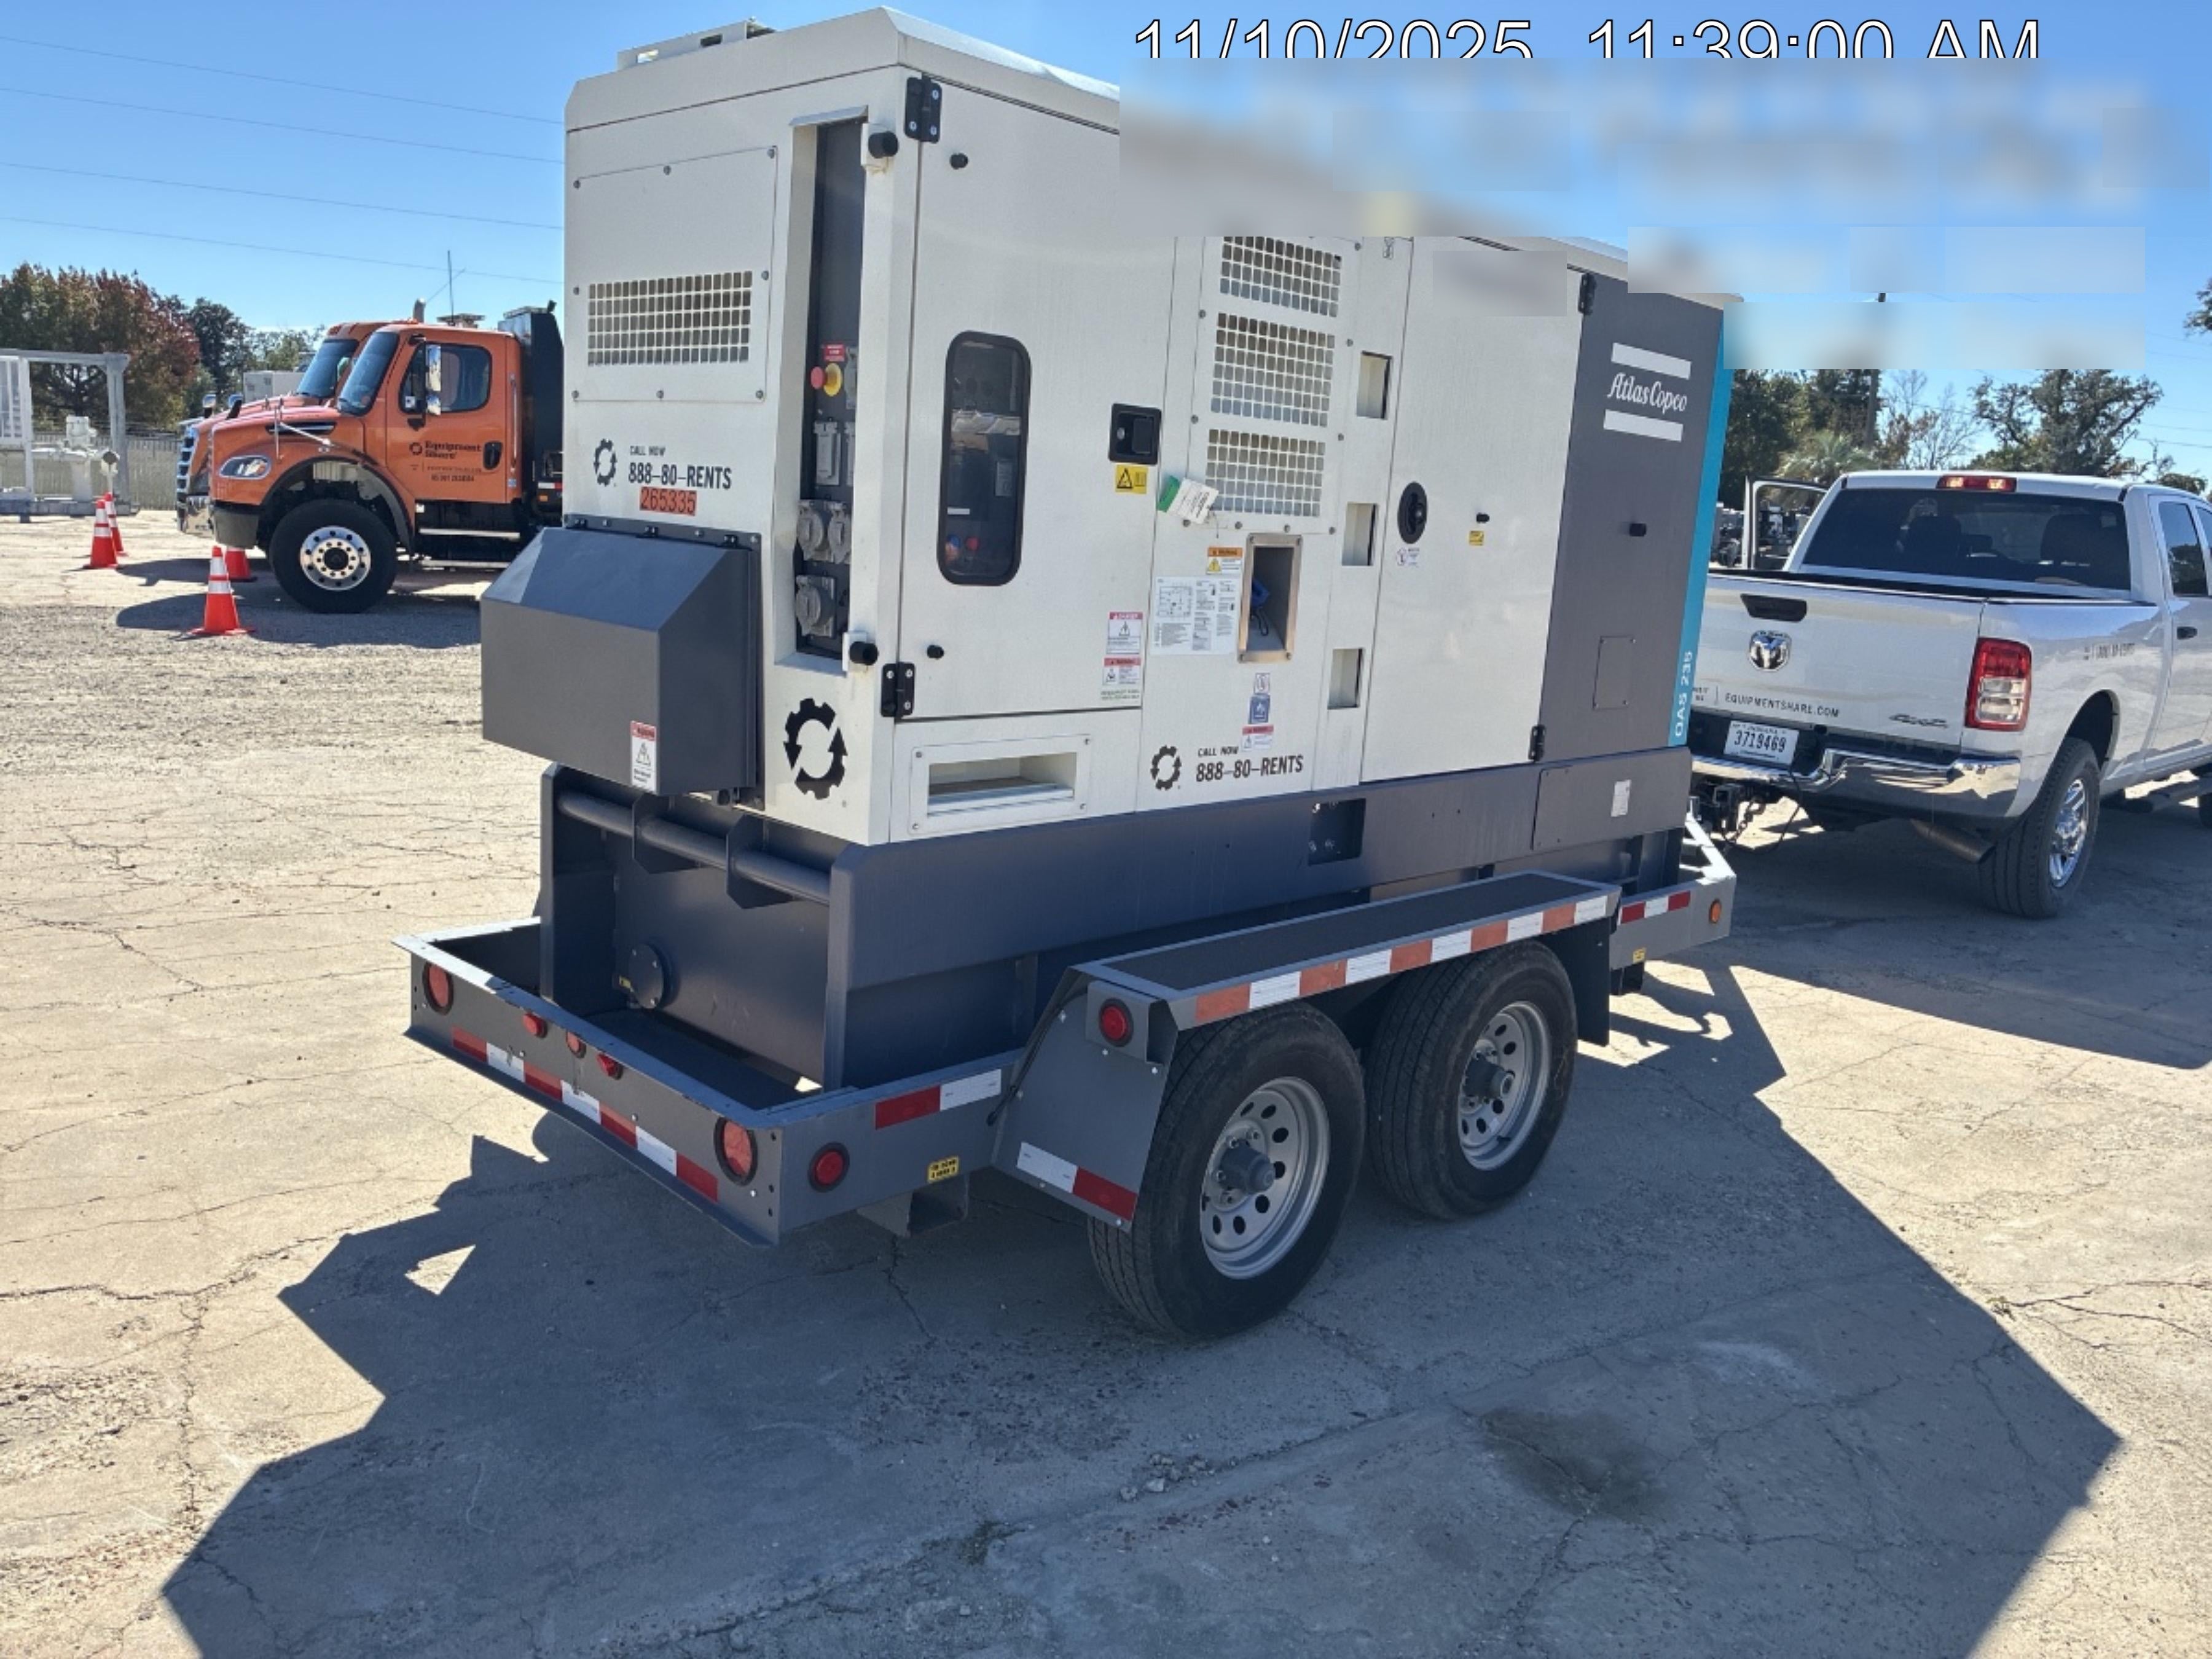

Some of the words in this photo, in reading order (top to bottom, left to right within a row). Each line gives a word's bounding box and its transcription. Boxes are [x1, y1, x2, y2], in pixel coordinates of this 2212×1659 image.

[1606, 372, 1650, 405] Atlas
[1649, 380, 1688, 415] Copco
[425, 441, 482, 452] Equipment
[629, 445, 645, 456] CALL
[648, 445, 666, 457] NOW
[628, 461, 732, 490] 888-80-RENTS
[641, 487, 696, 514] 265335
[1725, 692, 1840, 718] EQUIPMENTSHARE.COM
[1198, 748, 1217, 757] CALL
[1220, 746, 1239, 755] NOW
[1734, 729, 1787, 753] 3719469
[1196, 754, 1304, 783] 888-80-RENTS
